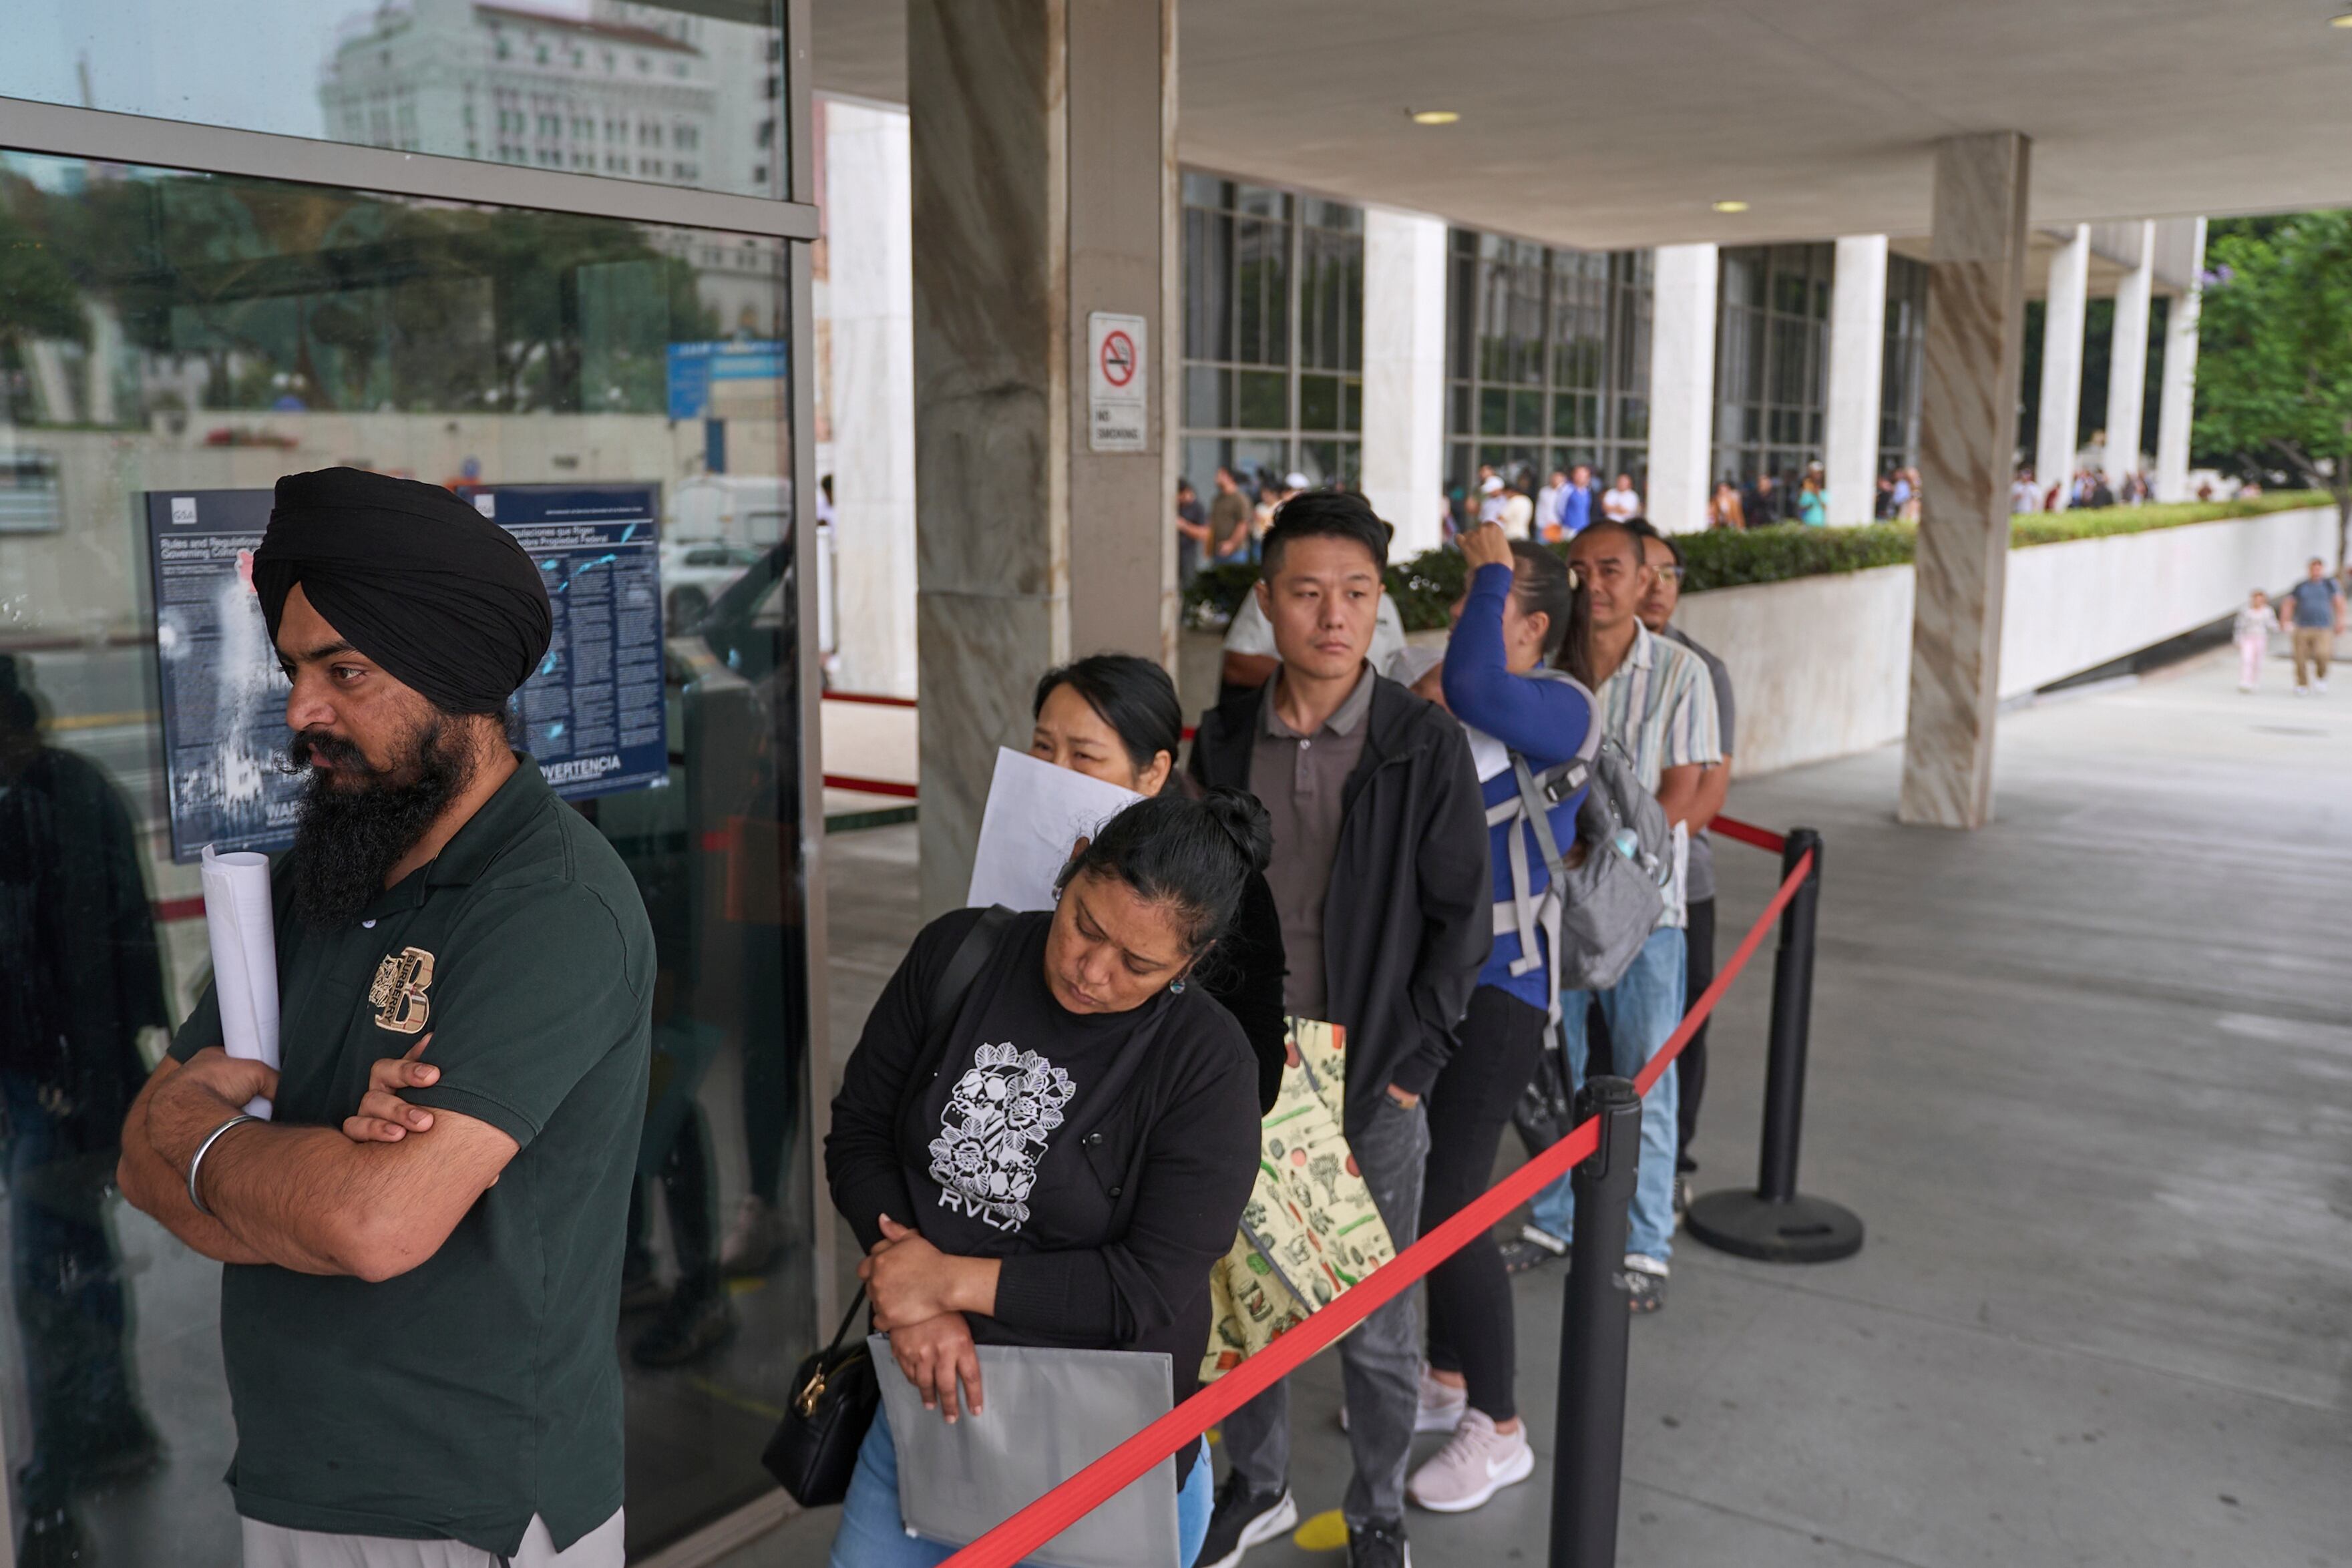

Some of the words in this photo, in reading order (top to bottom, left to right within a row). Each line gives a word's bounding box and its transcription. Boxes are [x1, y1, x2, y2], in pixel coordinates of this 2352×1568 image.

[172, 510, 194, 520] GSA
[557, 528, 571, 537] que
[572, 526, 595, 535] Rigen
[160, 538, 188, 549] Rules
[189, 537, 208, 548] and
[209, 536, 263, 548] Regulations
[540, 536, 578, 546] Propiedad
[580, 534, 608, 544] Federal
[160, 548, 210, 560] Governing
[384, 954, 415, 1024] BURBERRY
